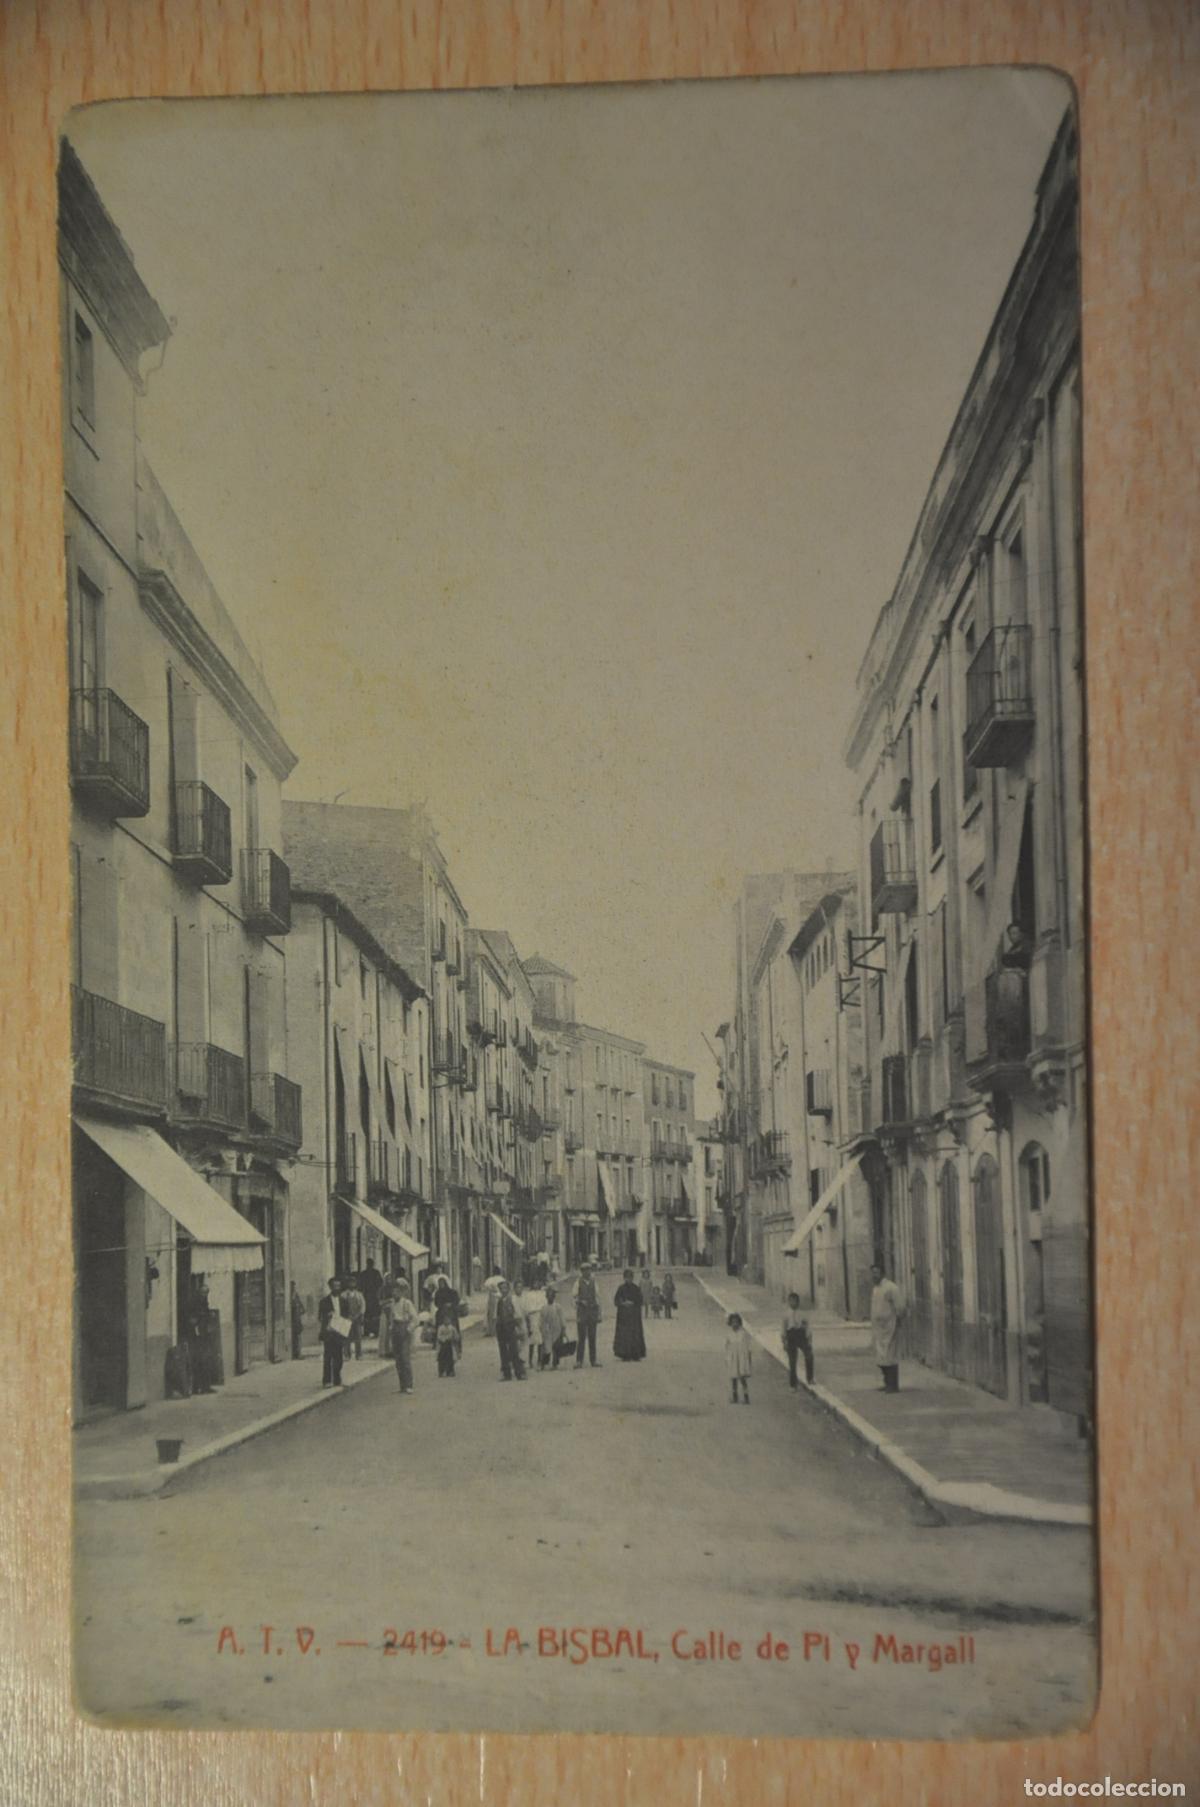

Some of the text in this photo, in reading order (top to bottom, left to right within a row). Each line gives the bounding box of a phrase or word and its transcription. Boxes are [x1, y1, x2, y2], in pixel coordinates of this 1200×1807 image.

[383, 1629, 446, 1656] 2419
[485, 1627, 522, 1657] LA
[538, 1627, 660, 1664] BISBAL,
[671, 1630, 742, 1661] Calle
[756, 1632, 790, 1661] de
[845, 1642, 860, 1670] y
[872, 1633, 975, 1672] Margall
